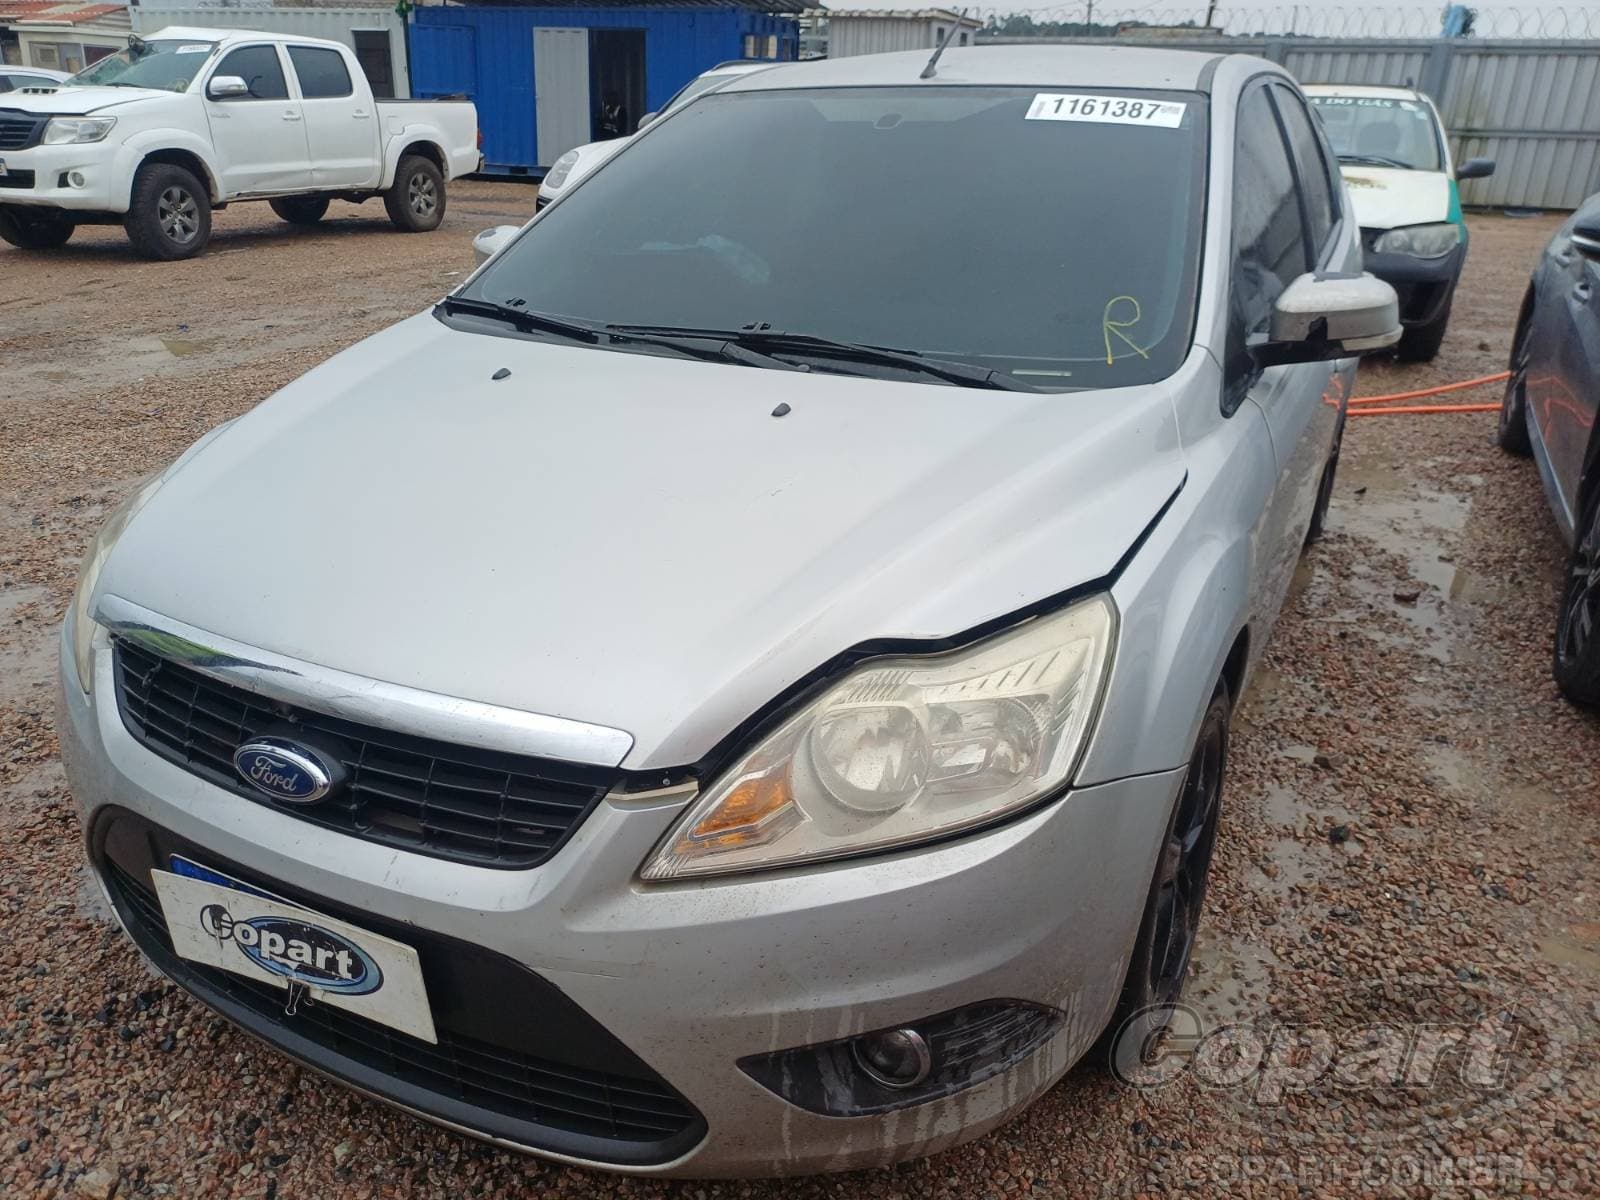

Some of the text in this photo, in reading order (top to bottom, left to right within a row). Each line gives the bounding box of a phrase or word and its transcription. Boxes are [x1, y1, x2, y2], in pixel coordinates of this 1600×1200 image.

[1053, 98, 1161, 120] 1161387
[1103, 295, 1149, 366] R
[250, 755, 297, 792] Ford
